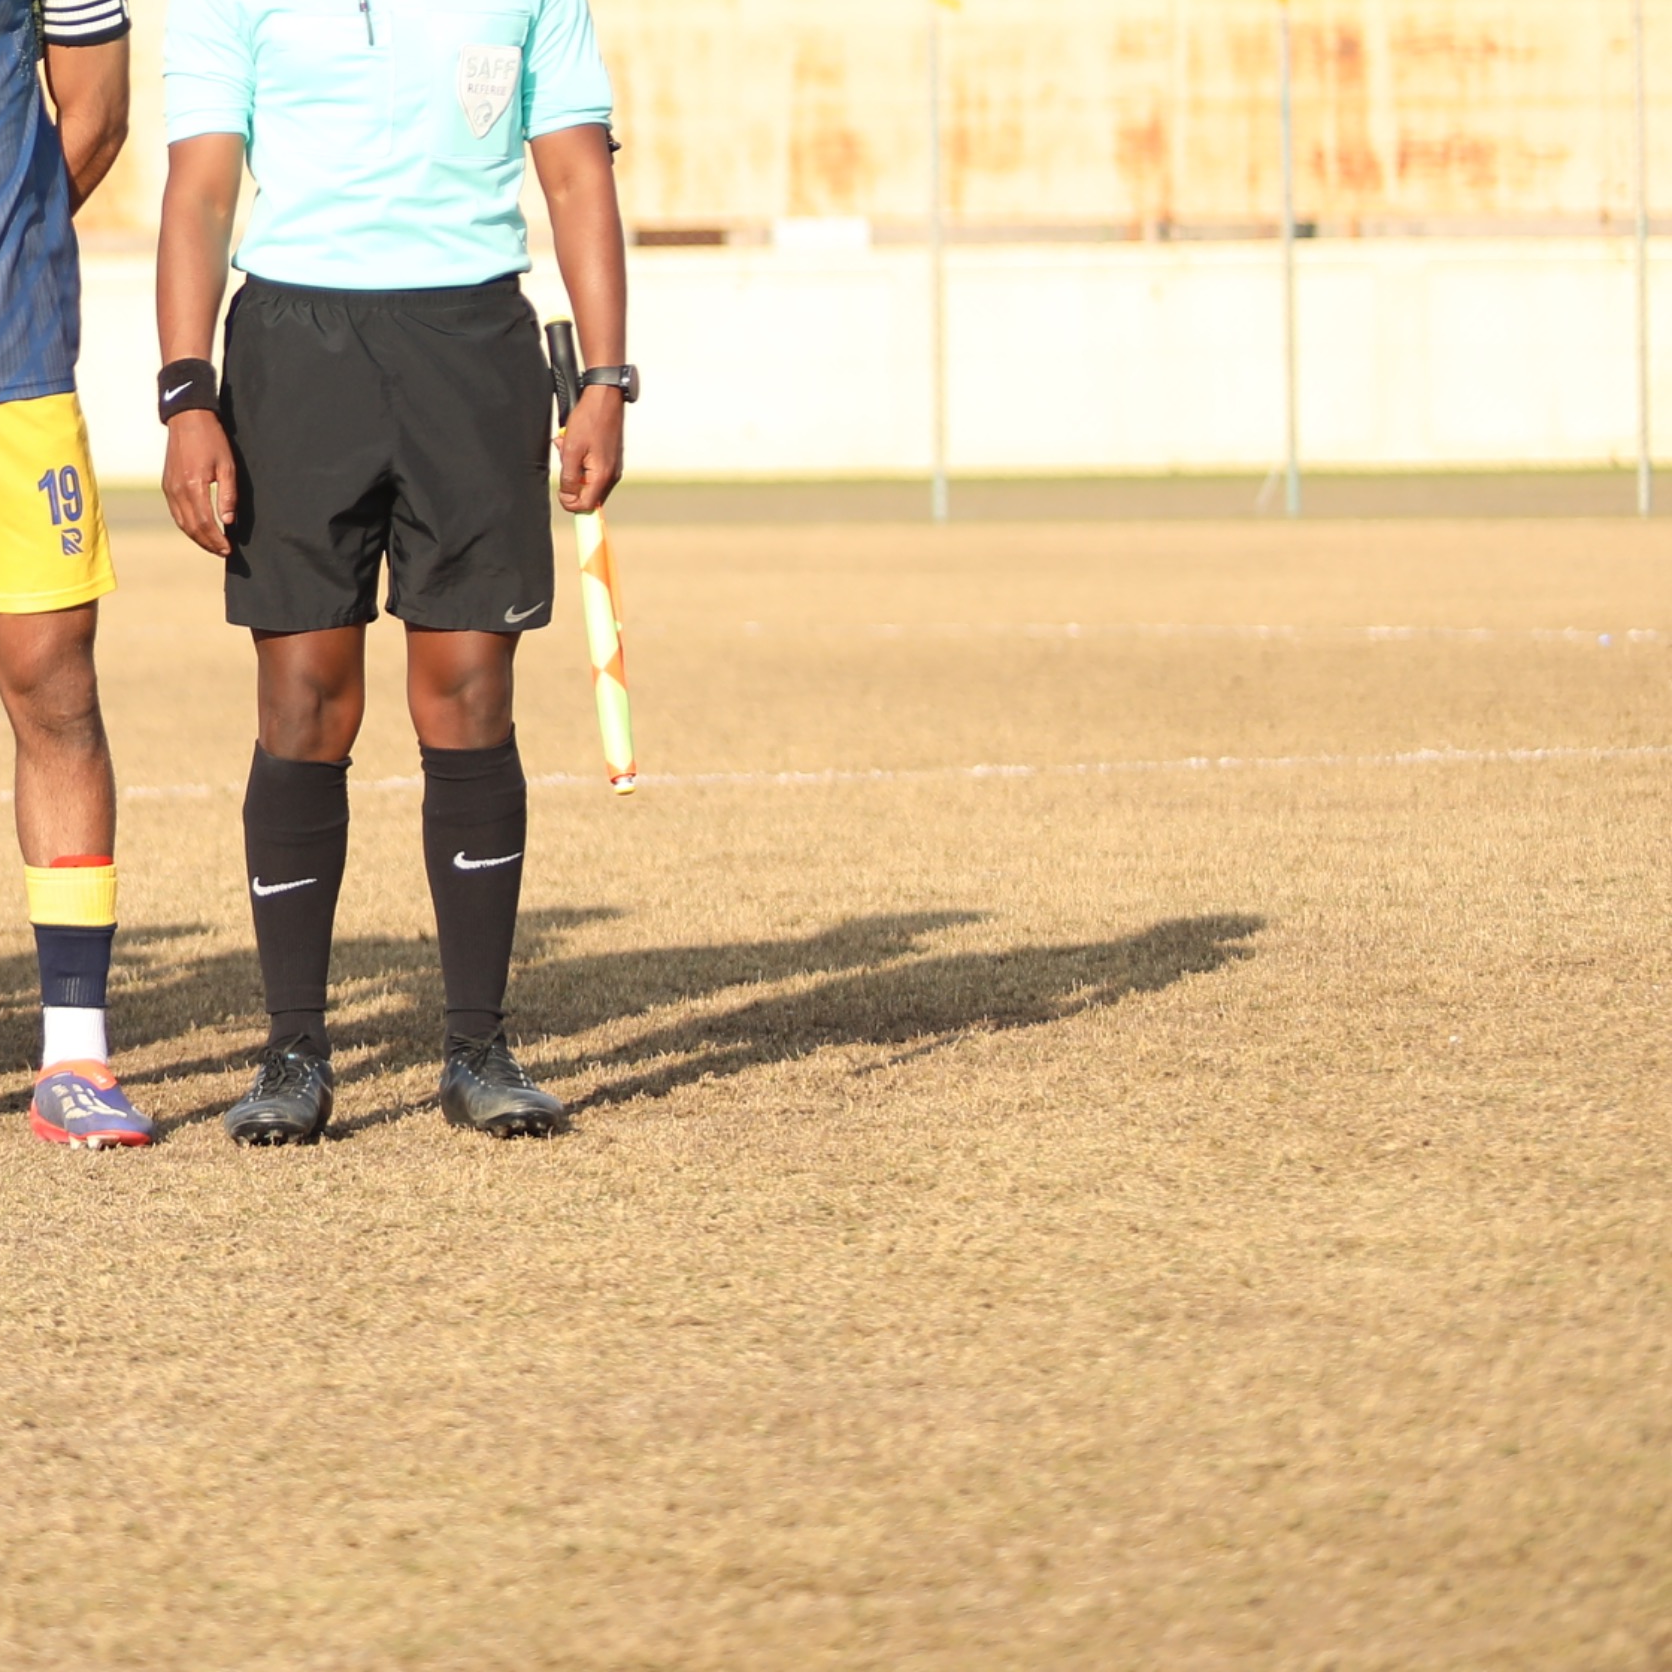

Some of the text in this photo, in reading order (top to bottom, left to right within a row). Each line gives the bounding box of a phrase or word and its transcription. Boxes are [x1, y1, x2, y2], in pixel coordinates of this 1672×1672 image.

[466, 57, 516, 80] SAFF
[467, 83, 507, 96] REFEREE
[38, 465, 83, 525] 19
